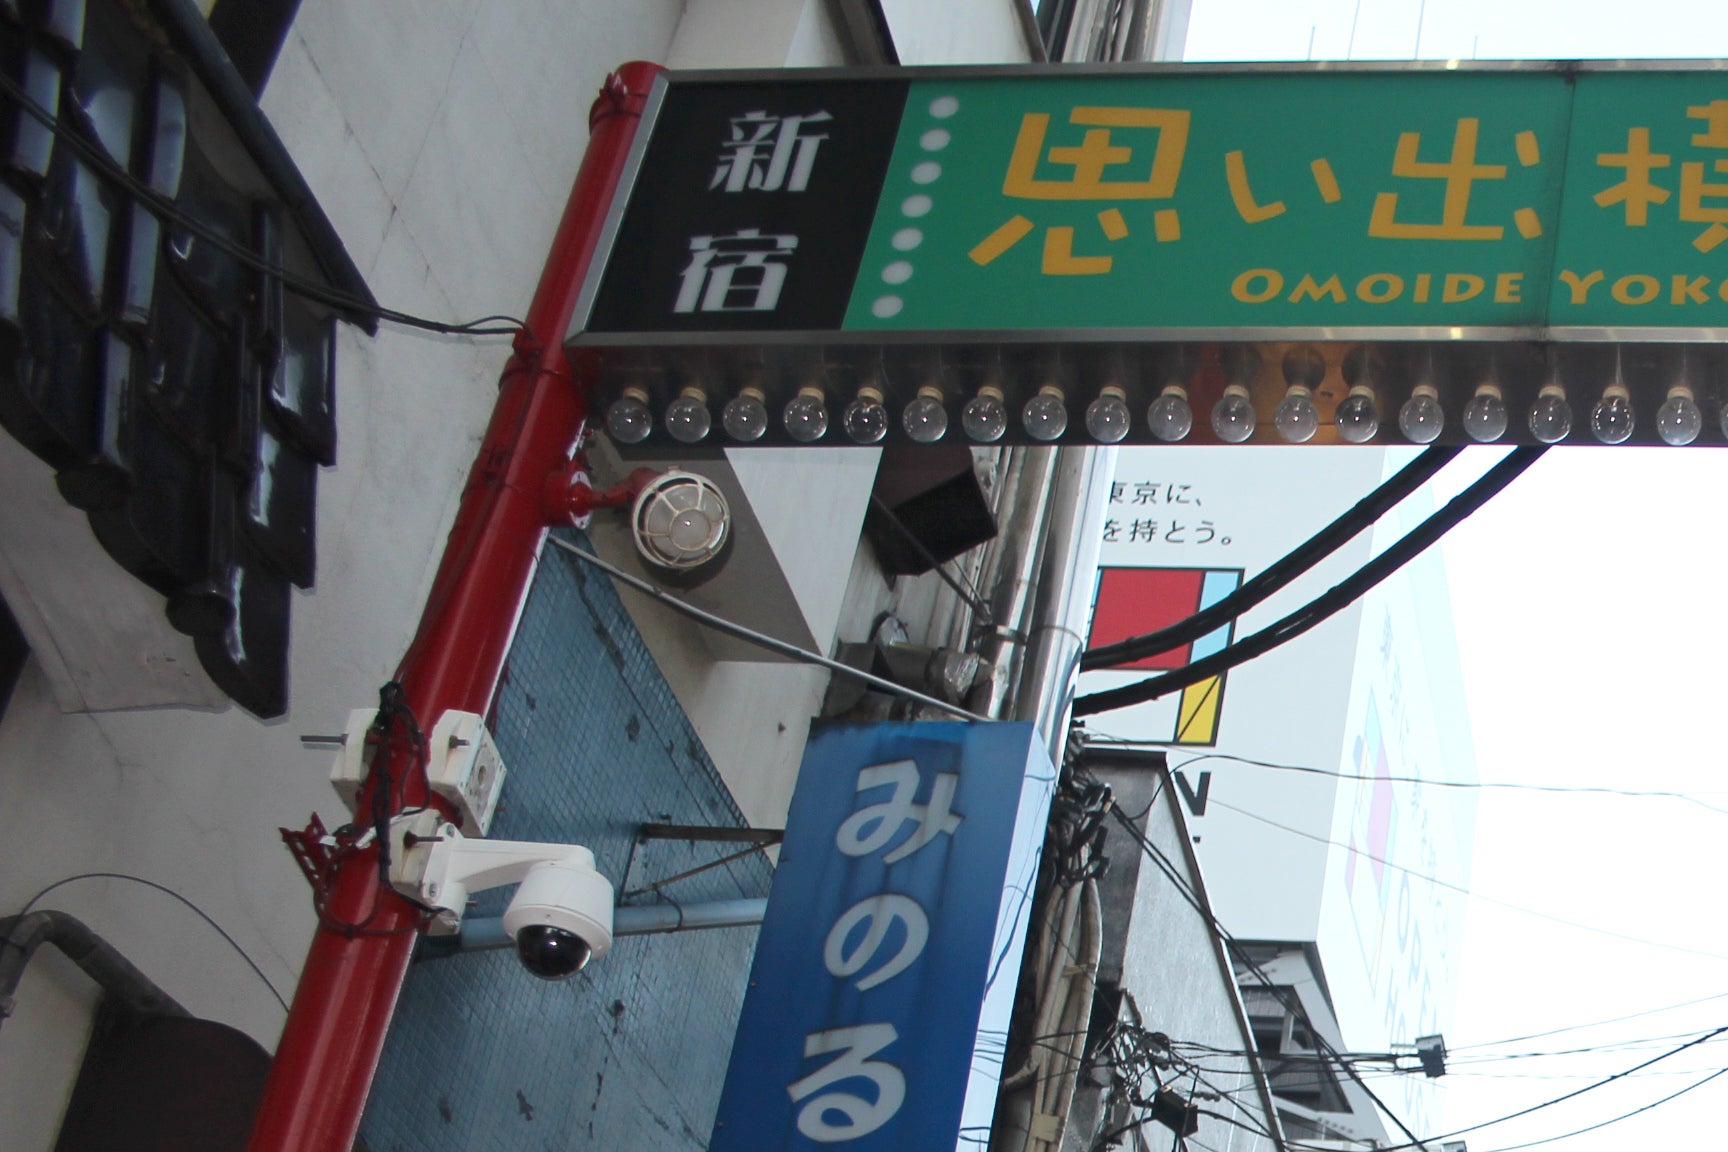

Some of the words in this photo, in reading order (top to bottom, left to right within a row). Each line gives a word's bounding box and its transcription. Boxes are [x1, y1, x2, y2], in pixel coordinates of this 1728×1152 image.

[671, 108, 834, 315] 新宿
[1229, 267, 1524, 305] OMOIDE
[786, 758, 966, 1144] みのる
